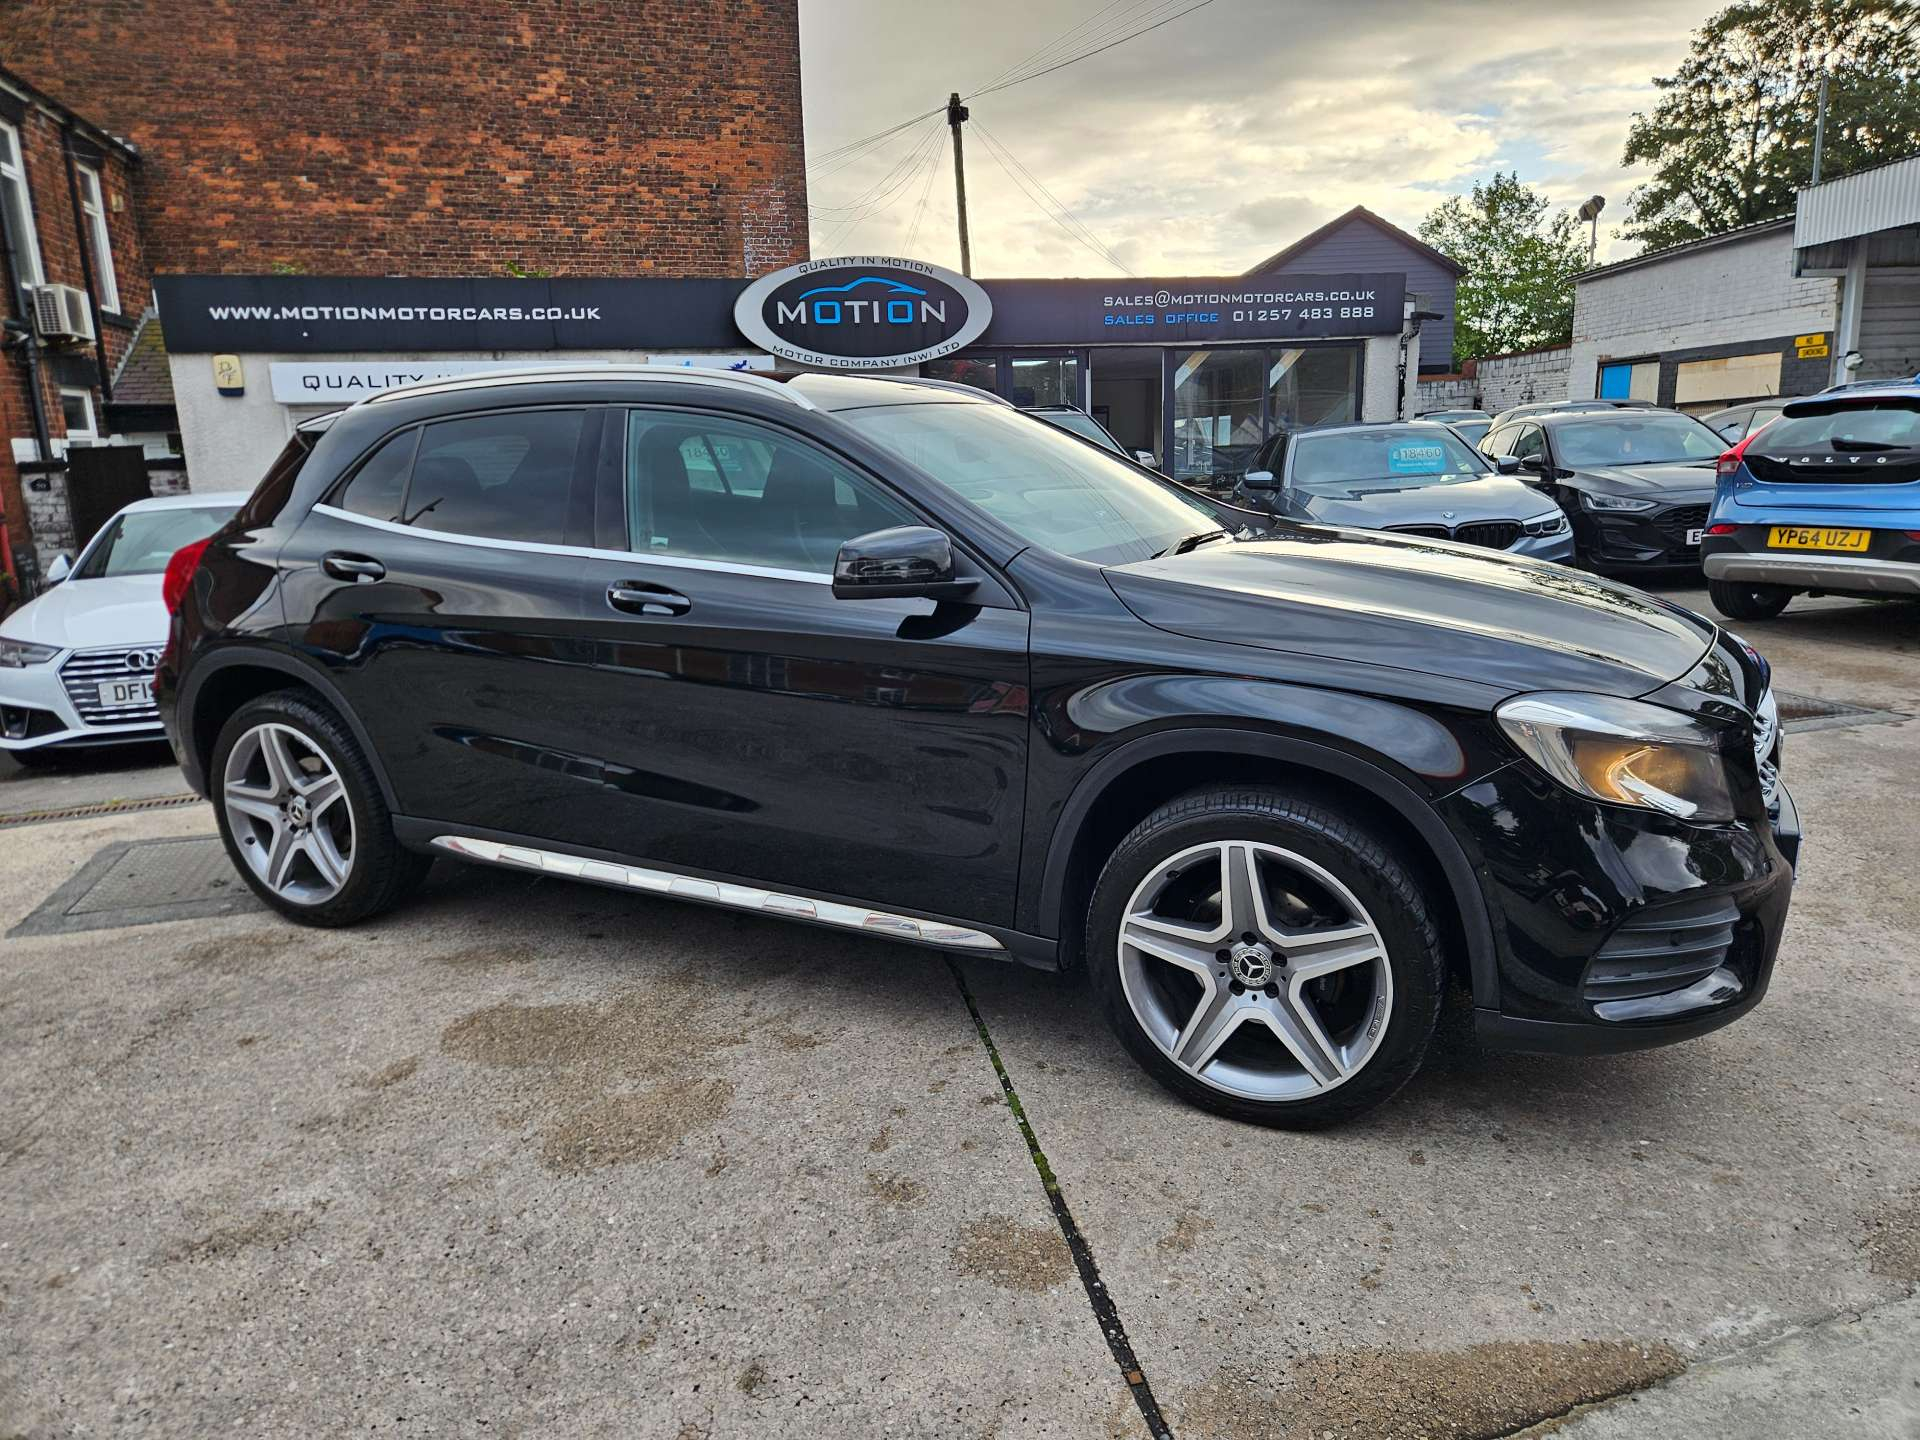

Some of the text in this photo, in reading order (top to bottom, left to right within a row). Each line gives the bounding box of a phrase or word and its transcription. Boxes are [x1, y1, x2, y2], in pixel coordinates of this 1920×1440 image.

[798, 257, 934, 275] QUALITY IN MOTION
[1103, 290, 1375, 308] SALES@MOTIONMOTORCARS.CO.UK
[208, 306, 601, 321] WWW.MOTIONMOTORCARS.CO.UK
[777, 300, 946, 325] MOTION
[1103, 306, 1374, 325] SALES OFFICE 01257 483 888
[772, 341, 961, 368] MOTOR COMPANY (NW) LTD
[302, 374, 424, 391] QUALITY
[1777, 456, 1887, 464] VOLVO
[1777, 529, 1864, 548] YP64 UZJ
